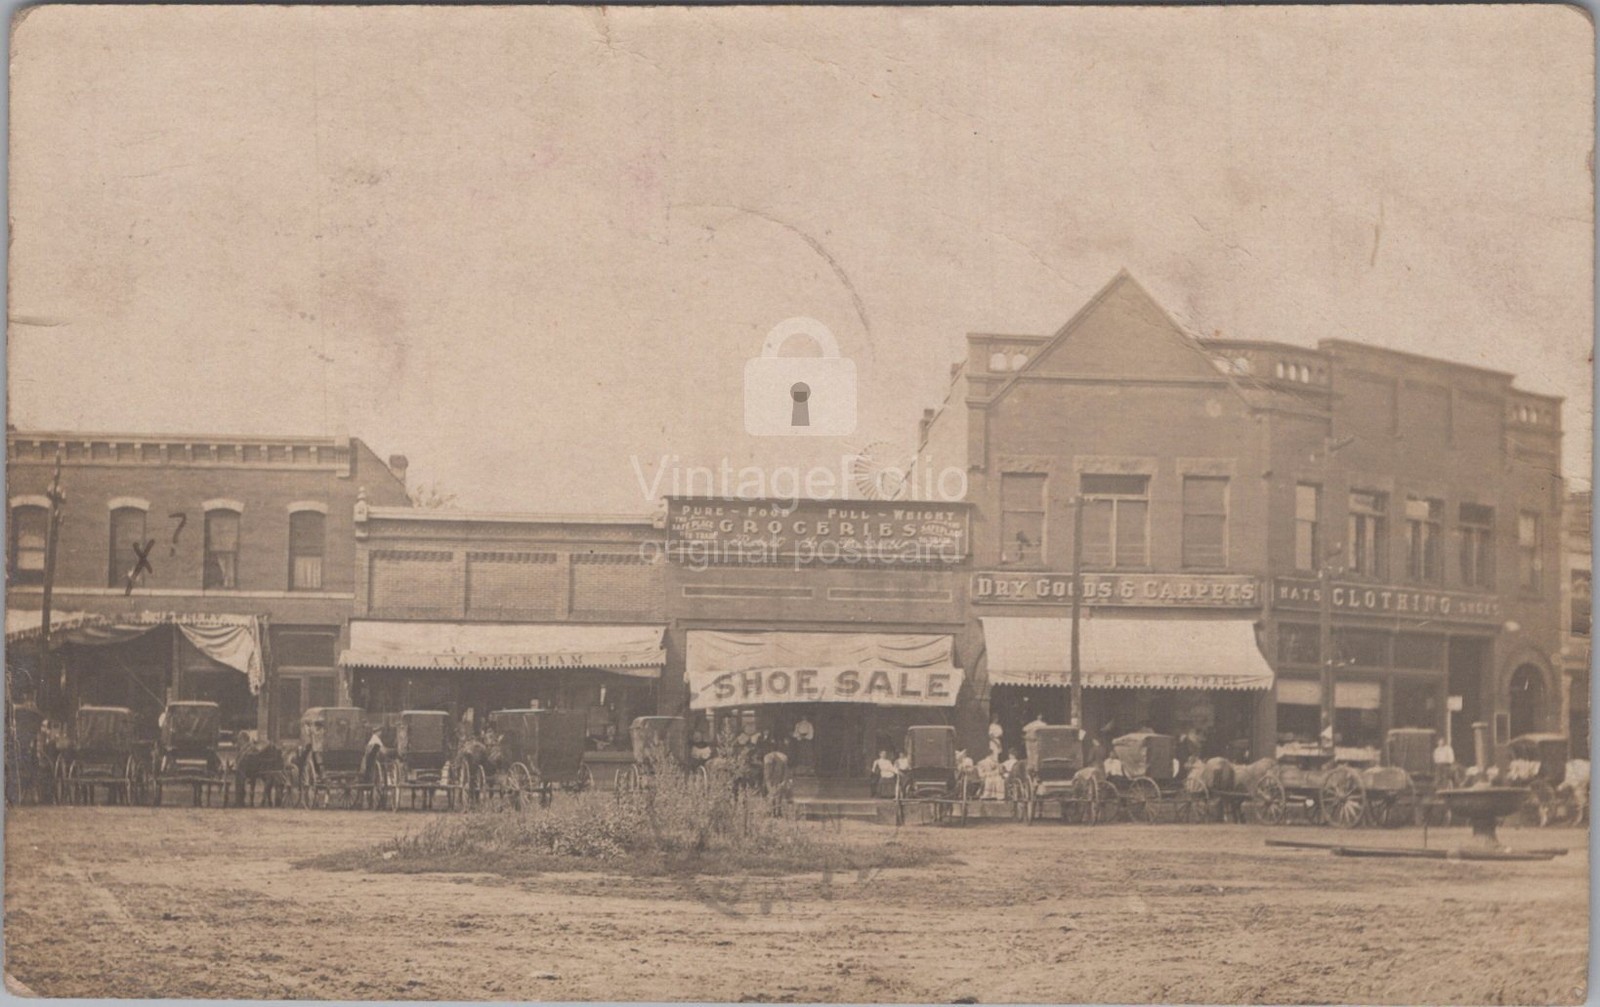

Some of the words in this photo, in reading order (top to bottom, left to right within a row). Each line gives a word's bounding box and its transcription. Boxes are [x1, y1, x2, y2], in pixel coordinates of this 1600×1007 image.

[682, 505, 724, 516] PURE
[828, 508, 870, 519] FULL
[894, 509, 954, 520] WEIGHT
[719, 519, 917, 537] GROCERIES
[978, 577, 1028, 597] DRY
[1119, 583, 1136, 599] &
[1143, 582, 1256, 602] CARPETS
[1280, 586, 1321, 602] HATS
[1333, 588, 1450, 614] CLOTHING
[478, 654, 584, 667] PECKHAM
[714, 668, 820, 700] SHOE
[834, 670, 951, 698] SALE
[1104, 675, 1150, 685] PLACE
[1164, 675, 1180, 685] TO
